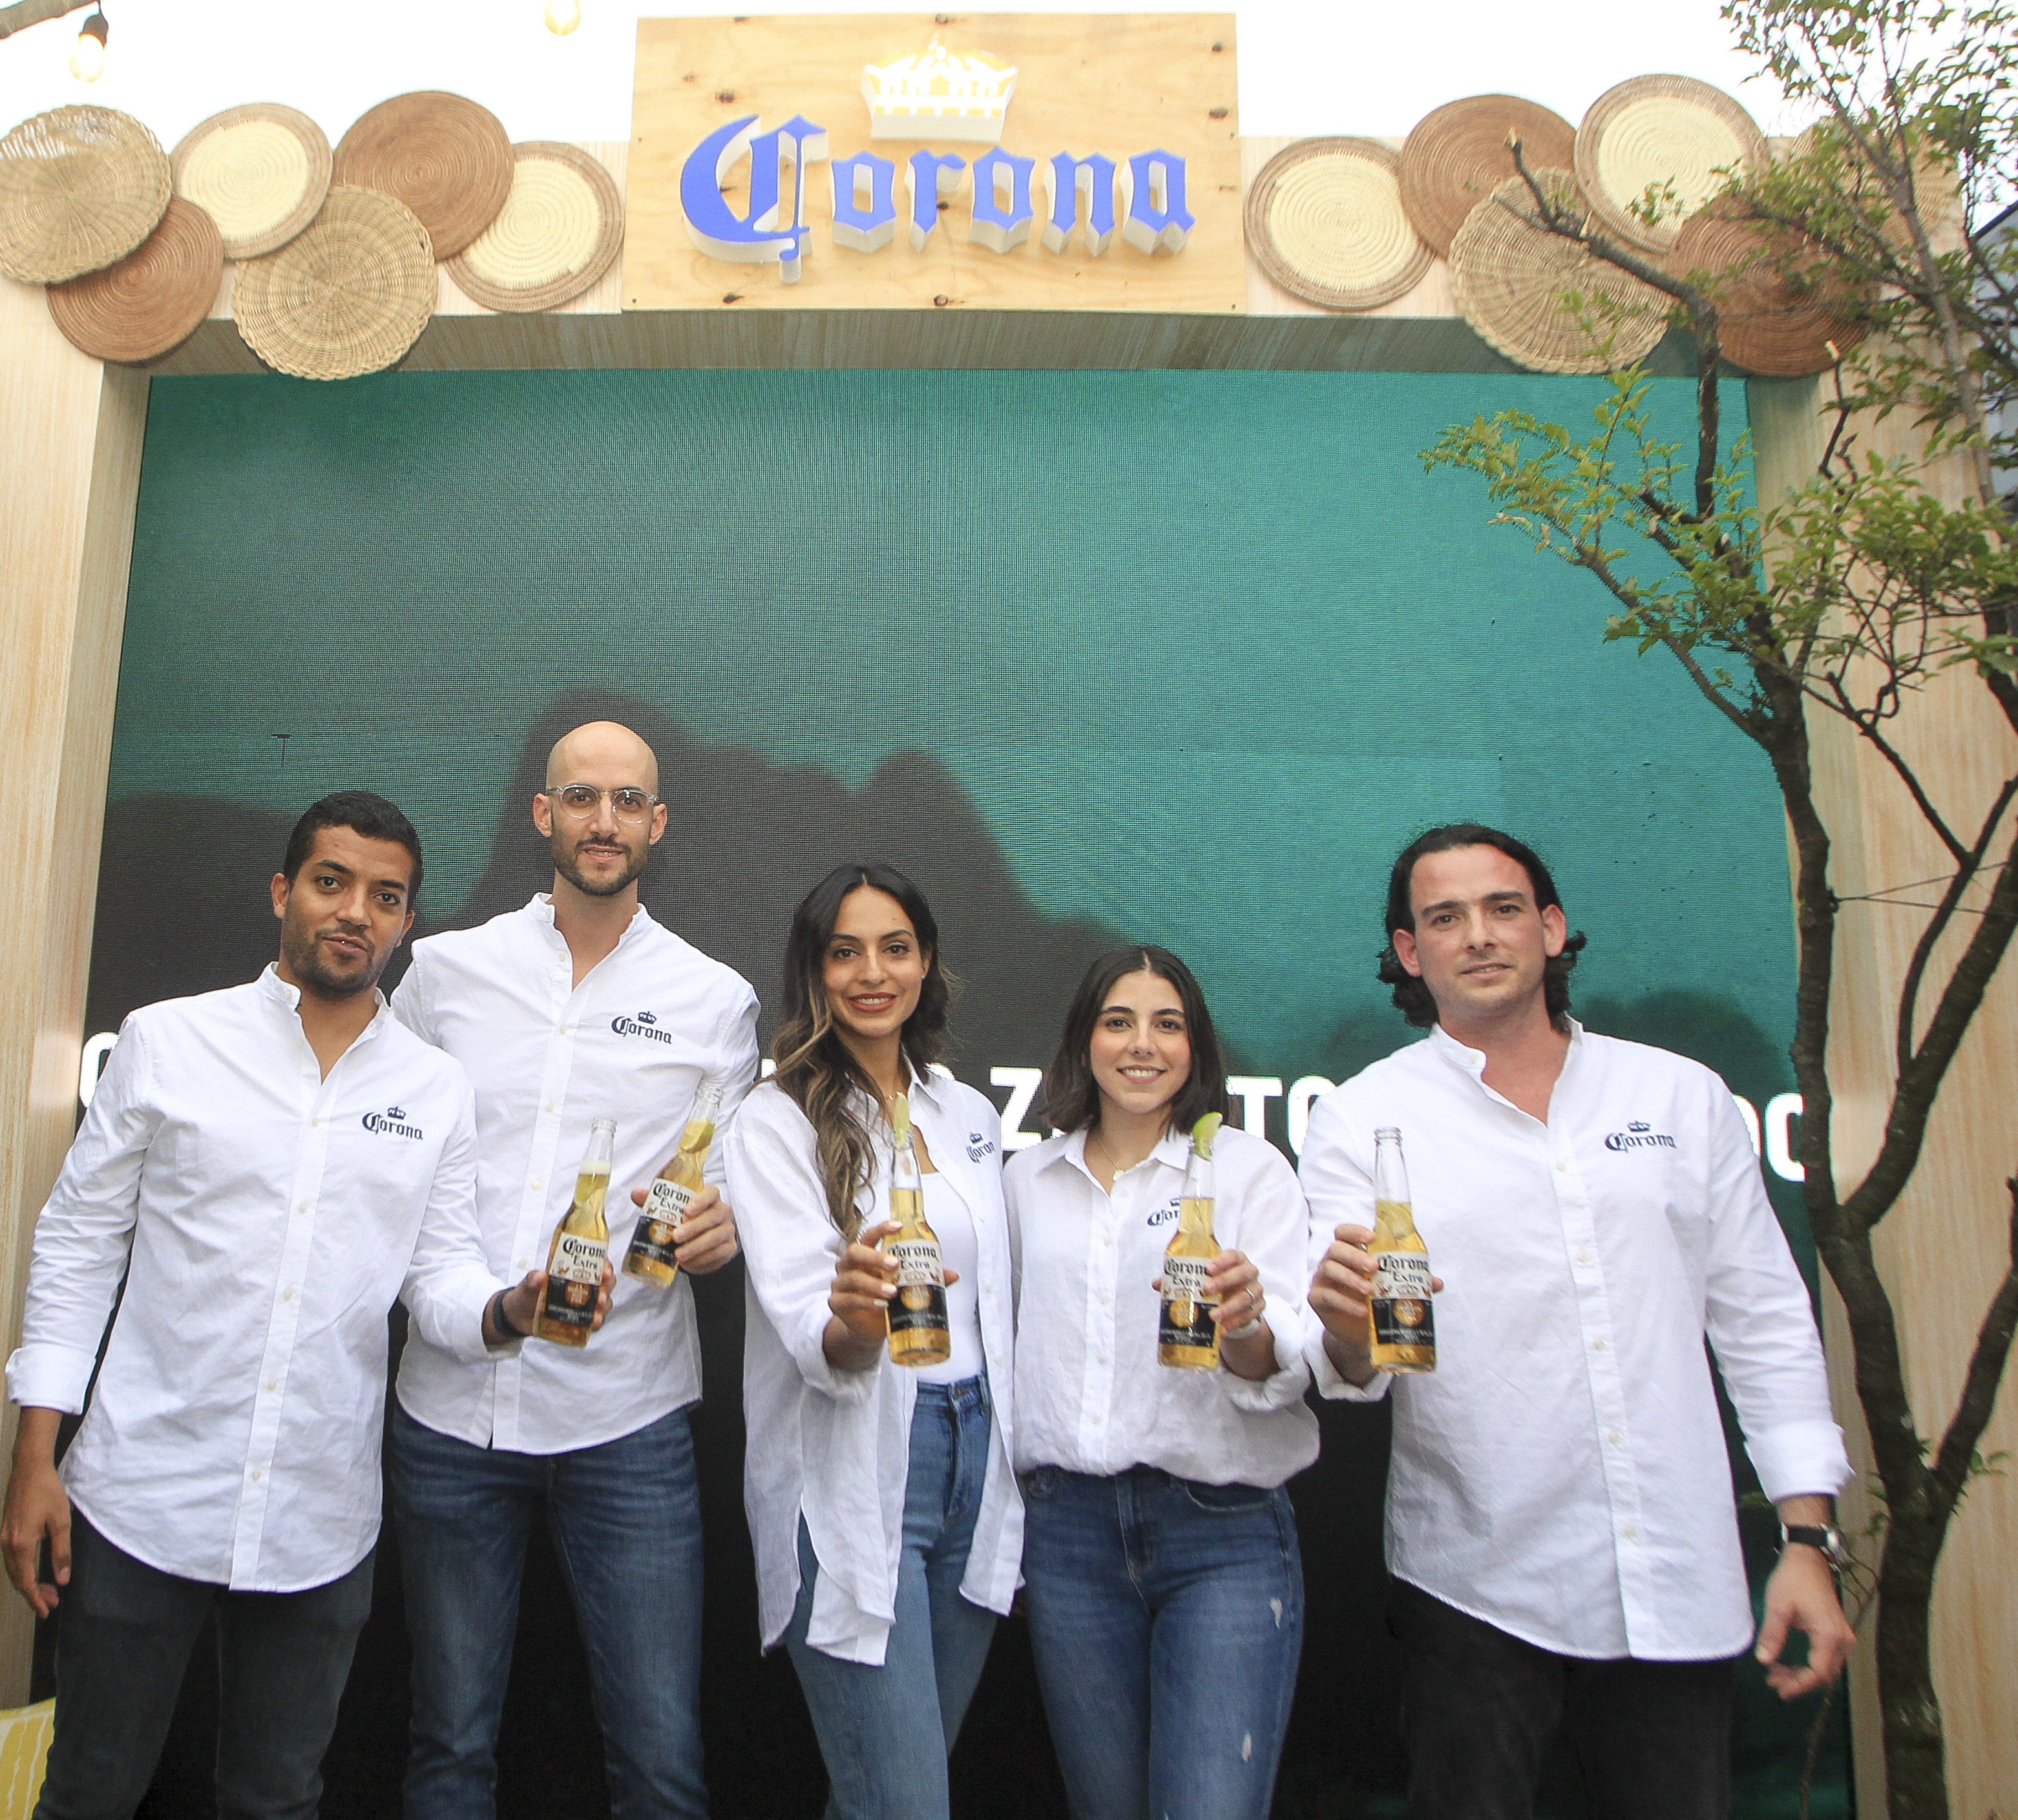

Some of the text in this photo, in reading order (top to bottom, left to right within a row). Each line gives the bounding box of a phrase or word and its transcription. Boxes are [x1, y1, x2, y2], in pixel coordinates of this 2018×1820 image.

[680, 114, 1195, 264] Corona
[611, 1016, 672, 1045] Corona
[362, 1111, 424, 1141] Corona
[965, 1141, 996, 1164] Coron
[1604, 1132, 1678, 1153] Corona
[653, 1182, 690, 1205] Coron
[1147, 1209, 1181, 1227] Cor
[574, 1255, 598, 1270] Extra
[1164, 1258, 1210, 1277] Coron
